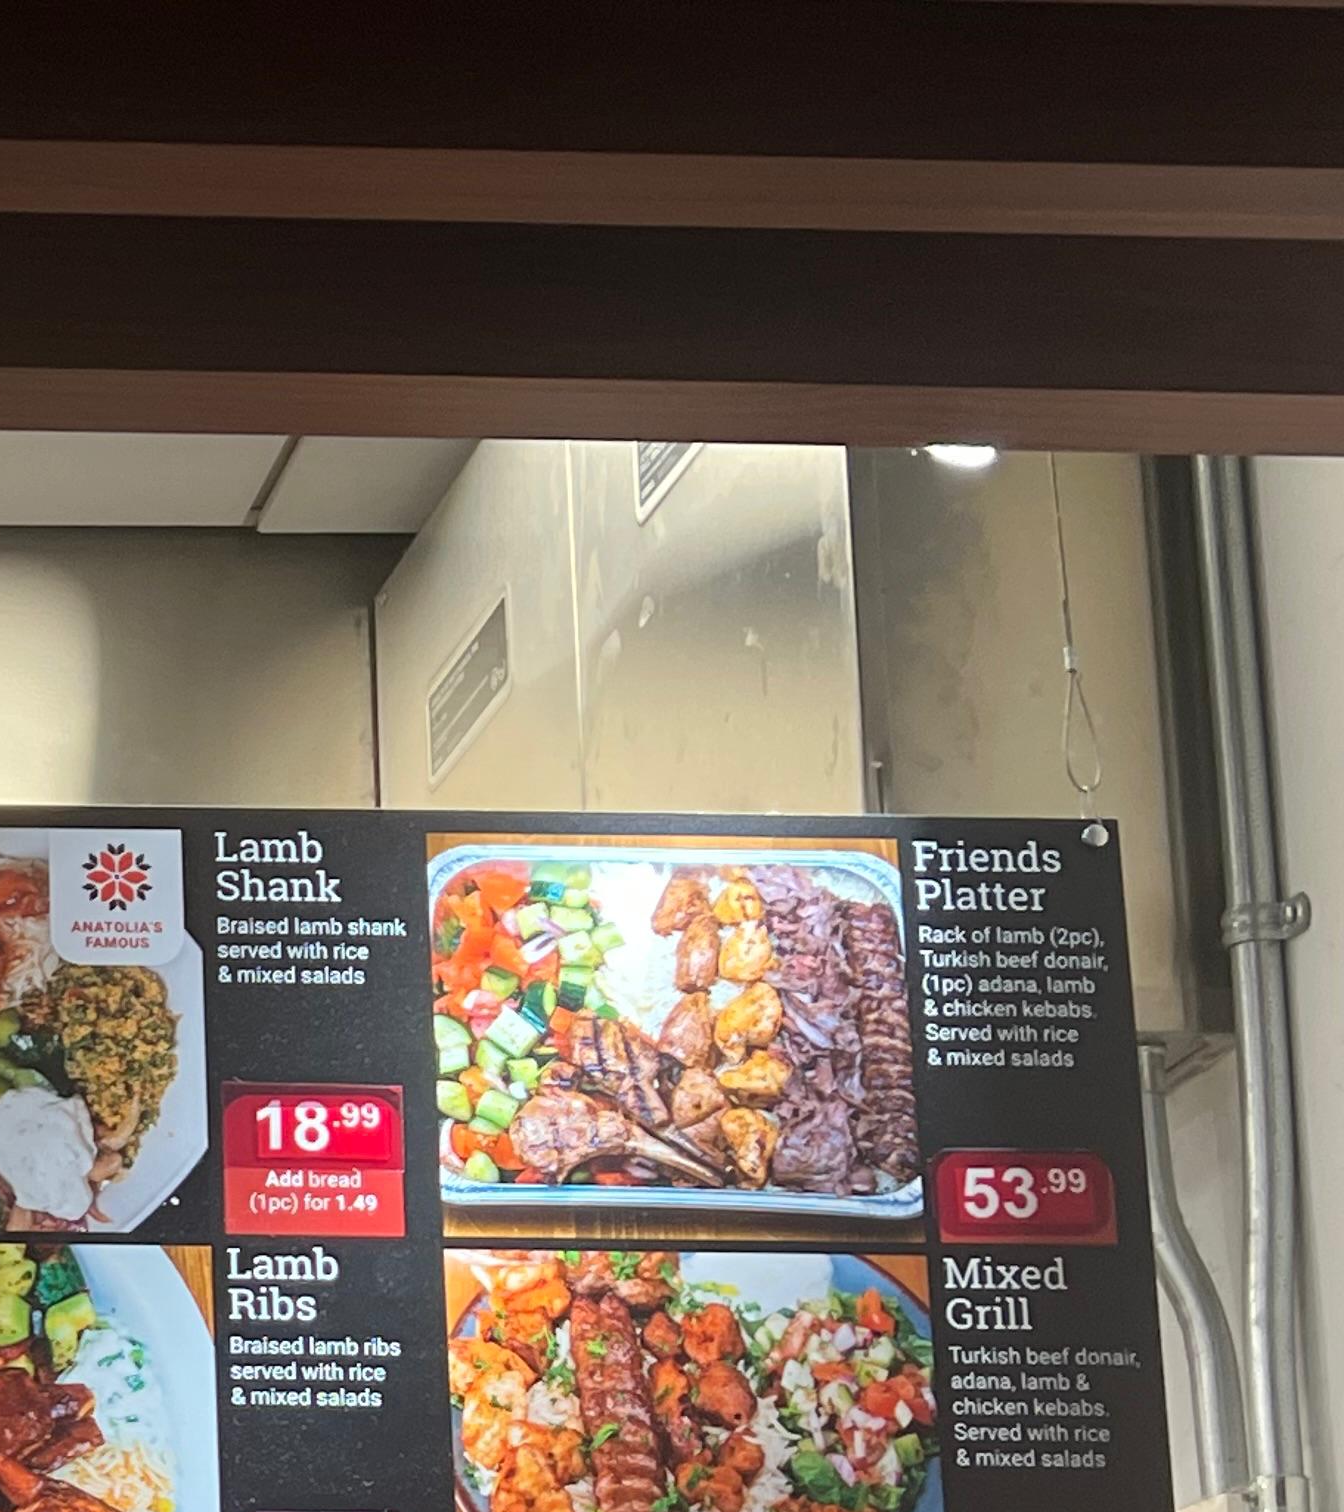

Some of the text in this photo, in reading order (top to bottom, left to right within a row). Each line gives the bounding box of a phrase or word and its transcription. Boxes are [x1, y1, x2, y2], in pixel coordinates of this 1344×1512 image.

[214, 830, 323, 864] Lamb
[911, 840, 1062, 873] Friends
[216, 868, 342, 903] Shank
[914, 877, 1046, 911] Platter
[71, 921, 162, 932] ANATOLIA'S
[86, 937, 149, 948] FAMOUS
[217, 916, 408, 937] Braised lamb shank
[217, 940, 370, 961] served with rice
[218, 965, 366, 985] & mixed salads
[255, 1099, 381, 1152] 18.99
[964, 1167, 1086, 1219] 53.99
[226, 1246, 339, 1282] Lamb
[942, 1256, 1068, 1290] Mixed
[227, 1286, 317, 1322] Ribs
[945, 1296, 1033, 1330] Grill
